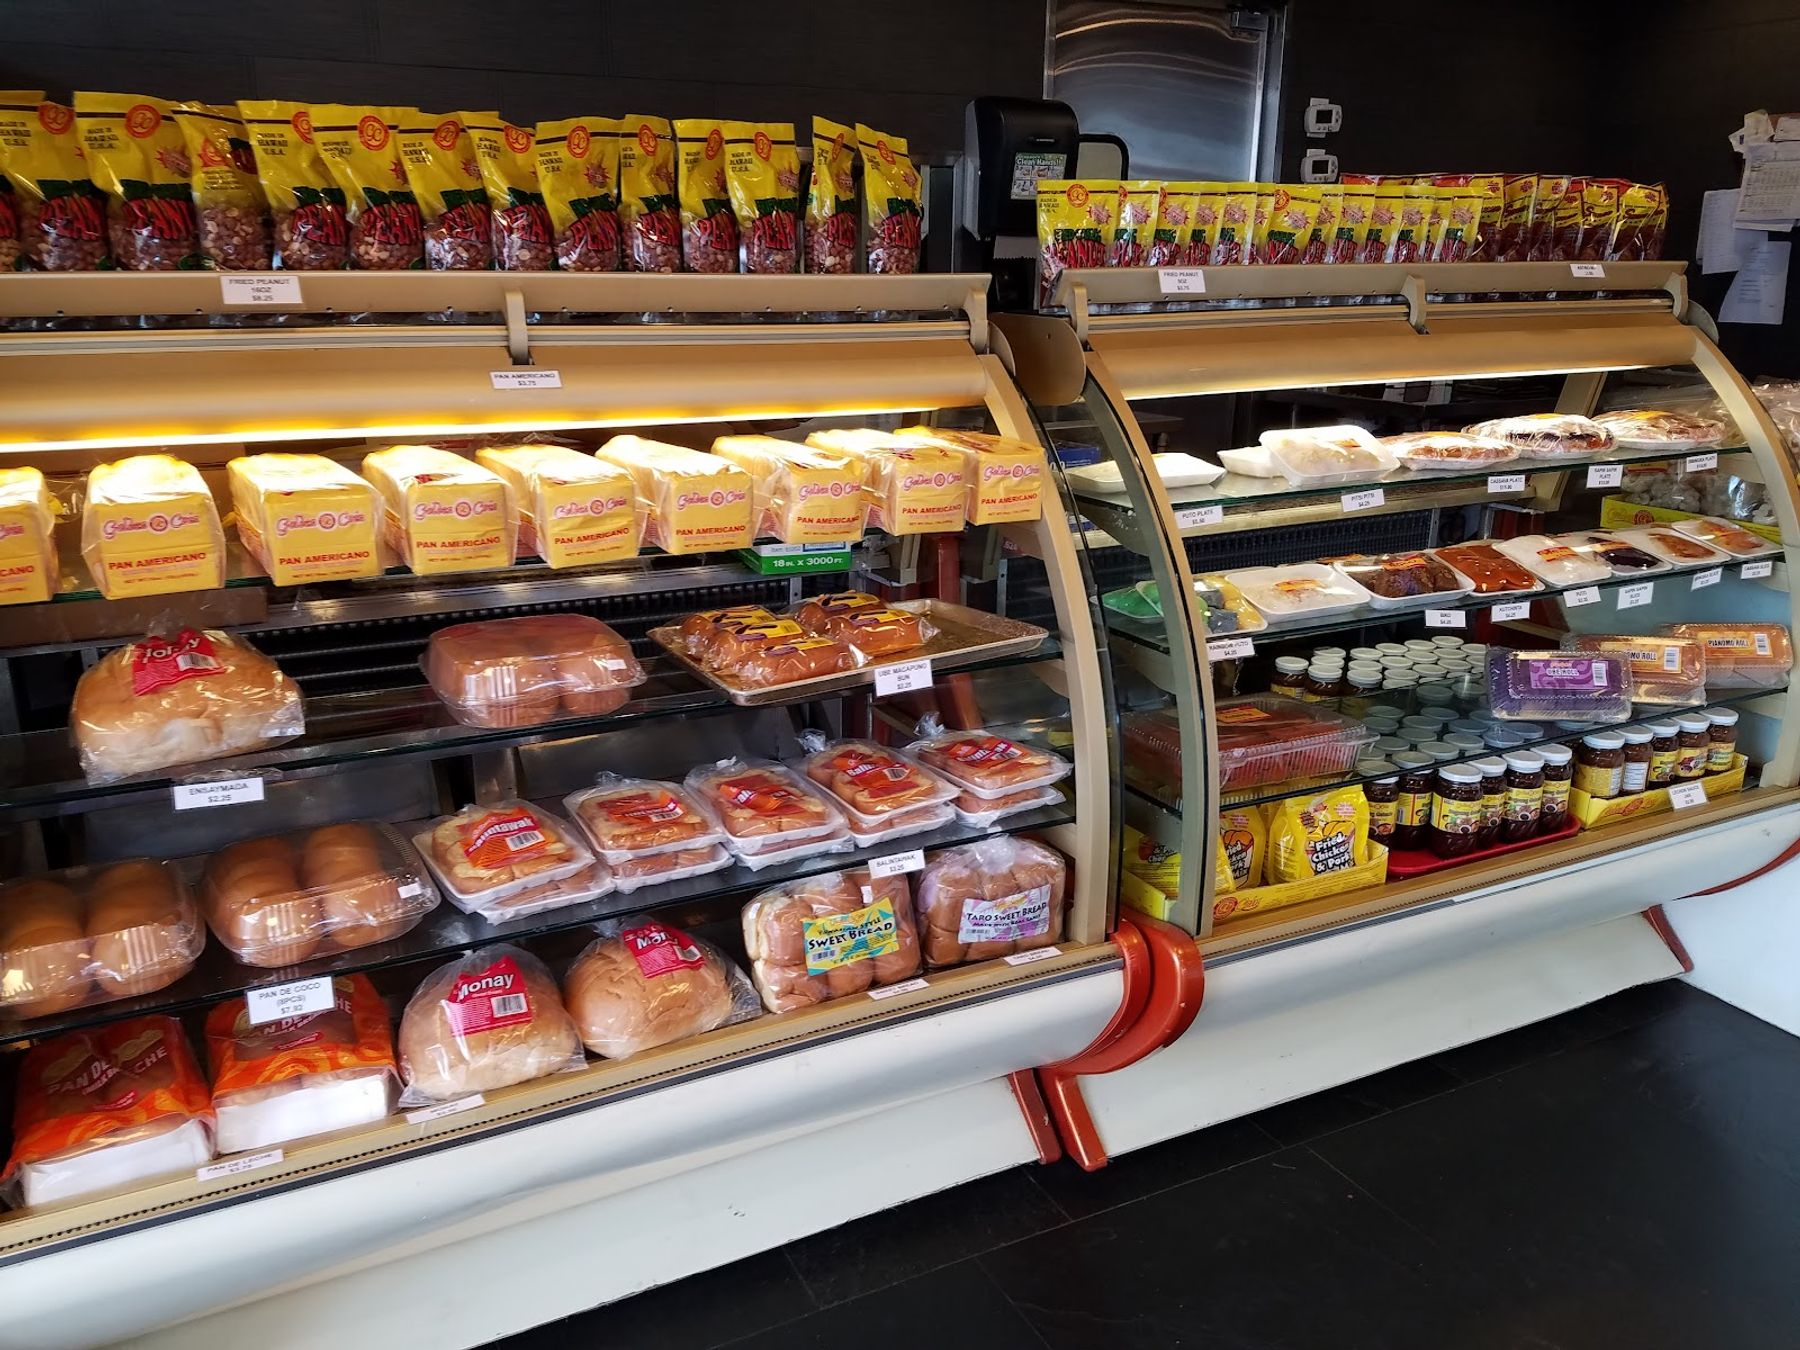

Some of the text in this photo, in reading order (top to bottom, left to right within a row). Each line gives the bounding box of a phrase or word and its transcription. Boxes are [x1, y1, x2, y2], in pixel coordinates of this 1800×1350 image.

[999, 493, 1038, 504] AMERICANO
[920, 504, 962, 514] AMERICANO
[816, 516, 860, 524] AMERICANO
[576, 528, 630, 543] AMERICANO
[696, 525, 746, 534] AMERICANO
[440, 537, 501, 548] AMERICANO
[109, 552, 206, 571] PAN AMERICANO
[279, 551, 370, 566] PAN AMERICANO
[1642, 652, 1657, 660] ROLL
[188, 783, 249, 796] ENSAYMADA
[1315, 832, 1345, 851] Fried
[876, 855, 917, 867] BALINTAWAK
[1316, 862, 1326, 872] &
[966, 902, 1047, 922] TARO SWEET BREAD
[808, 922, 893, 950] SWEET BREAD
[258, 982, 321, 1000] PAN DE COCO
